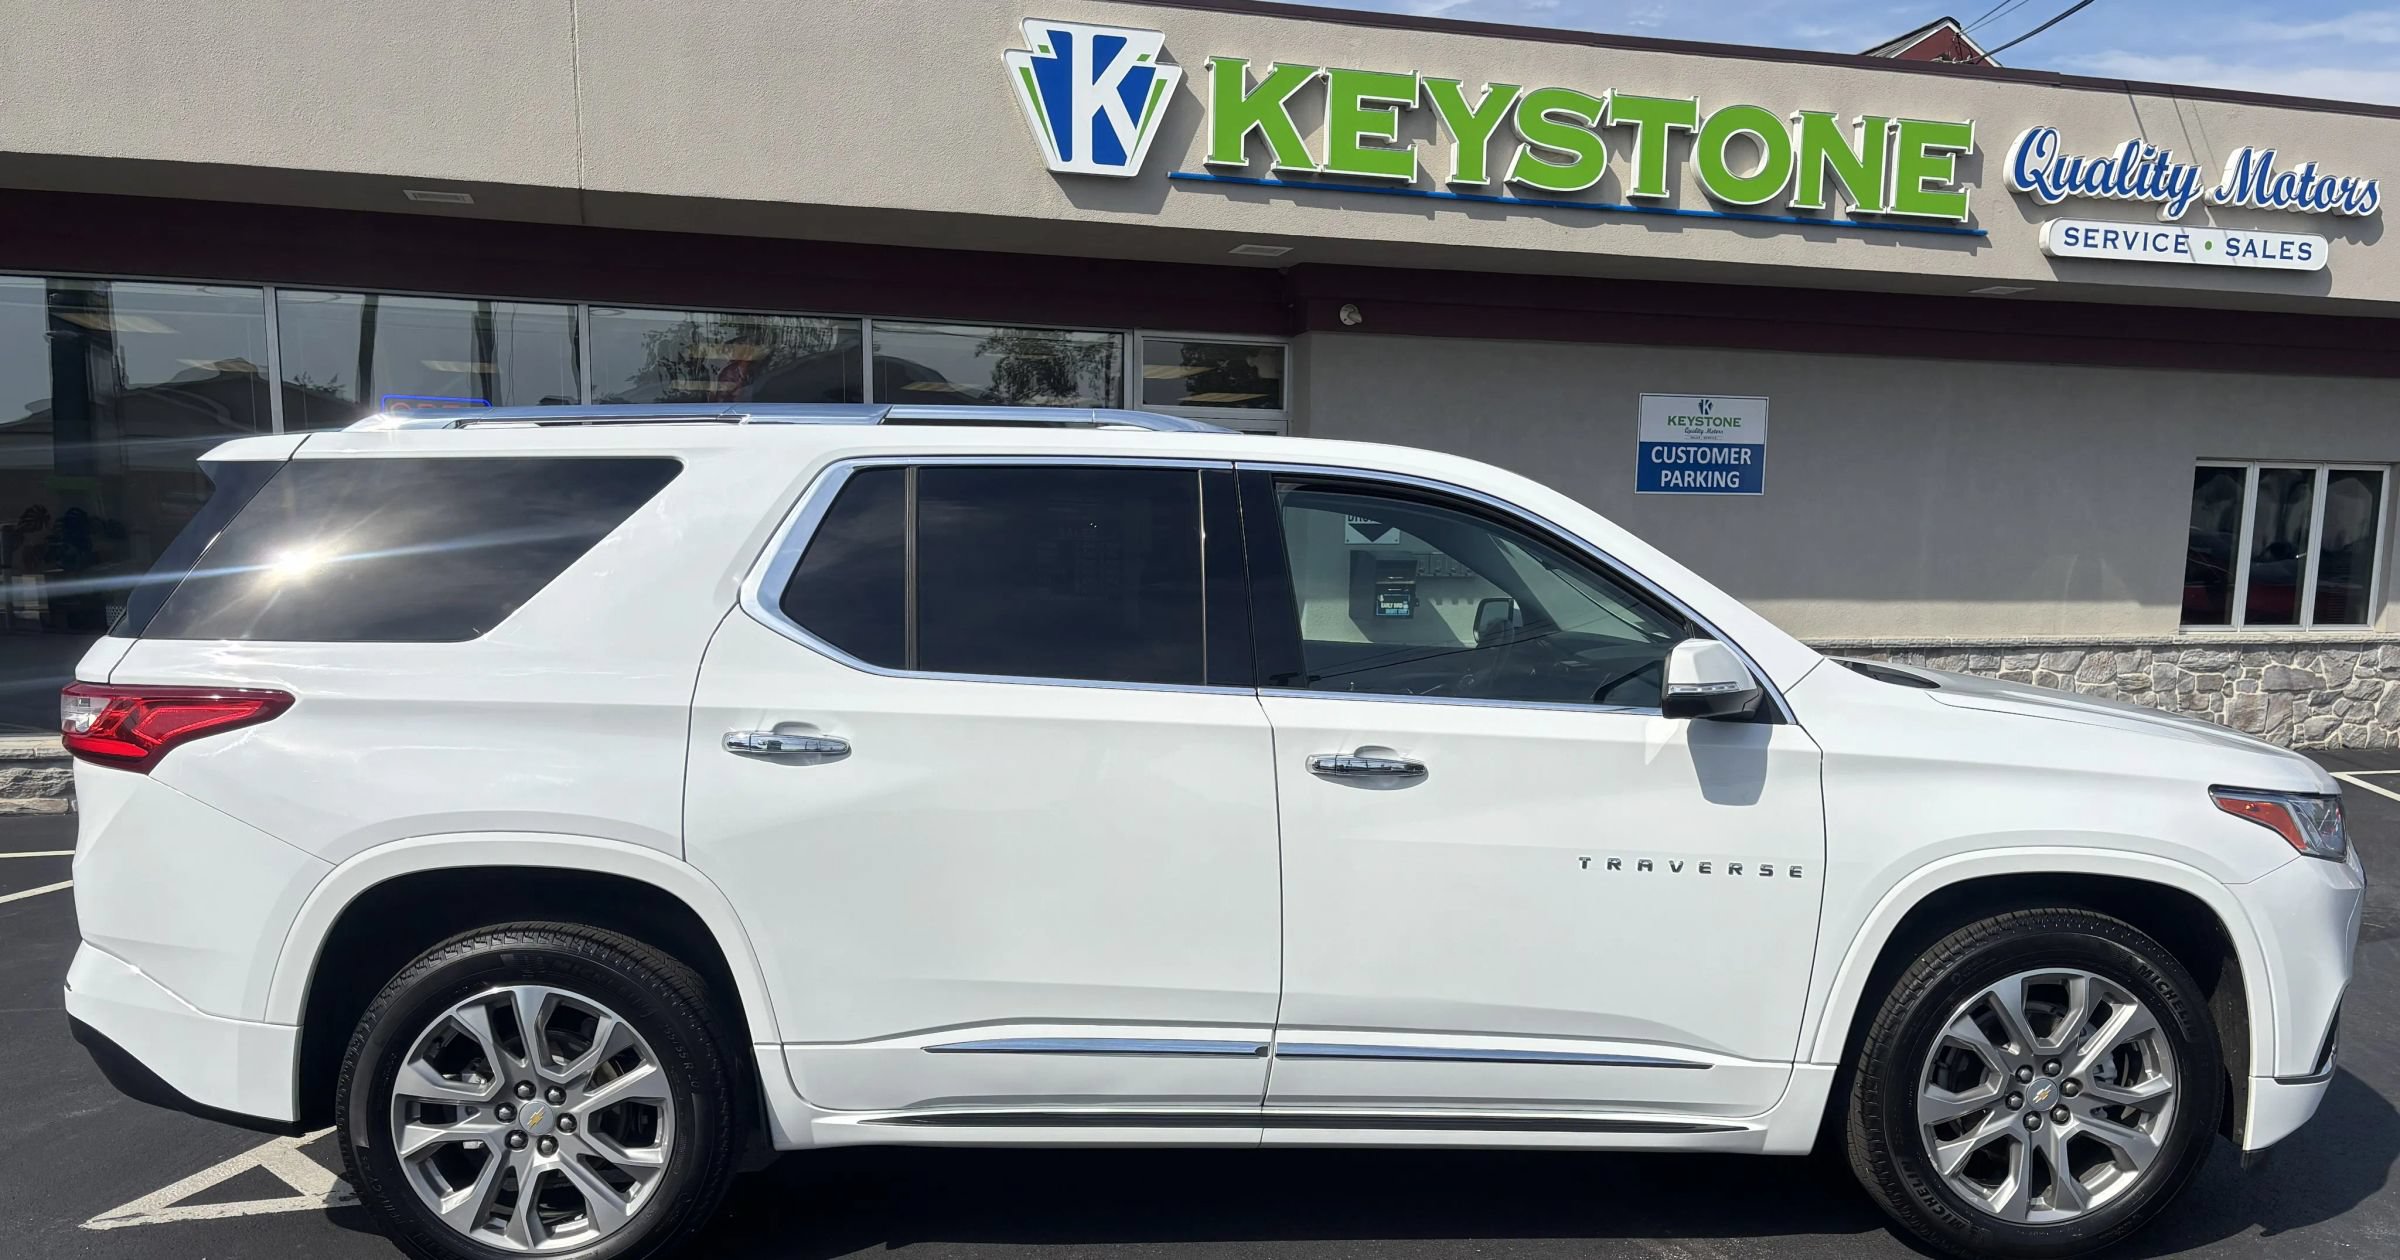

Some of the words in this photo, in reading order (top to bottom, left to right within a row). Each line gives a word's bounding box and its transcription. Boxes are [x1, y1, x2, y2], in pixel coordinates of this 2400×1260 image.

[1203, 55, 1975, 223] KEYSTONE
[2009, 125, 2202, 219] Quality
[2212, 145, 2380, 216] Motors
[2063, 226, 2190, 255] SERVICE
[2225, 237, 2313, 262] SALES
[1667, 415, 1742, 428] KEYSTONE
[1651, 445, 1752, 465] CUSTOMER
[1660, 470, 1740, 488] PARKING
[1578, 856, 1803, 878] TRAVERSE
[1901, 1160, 1967, 1231] MICHELIN
